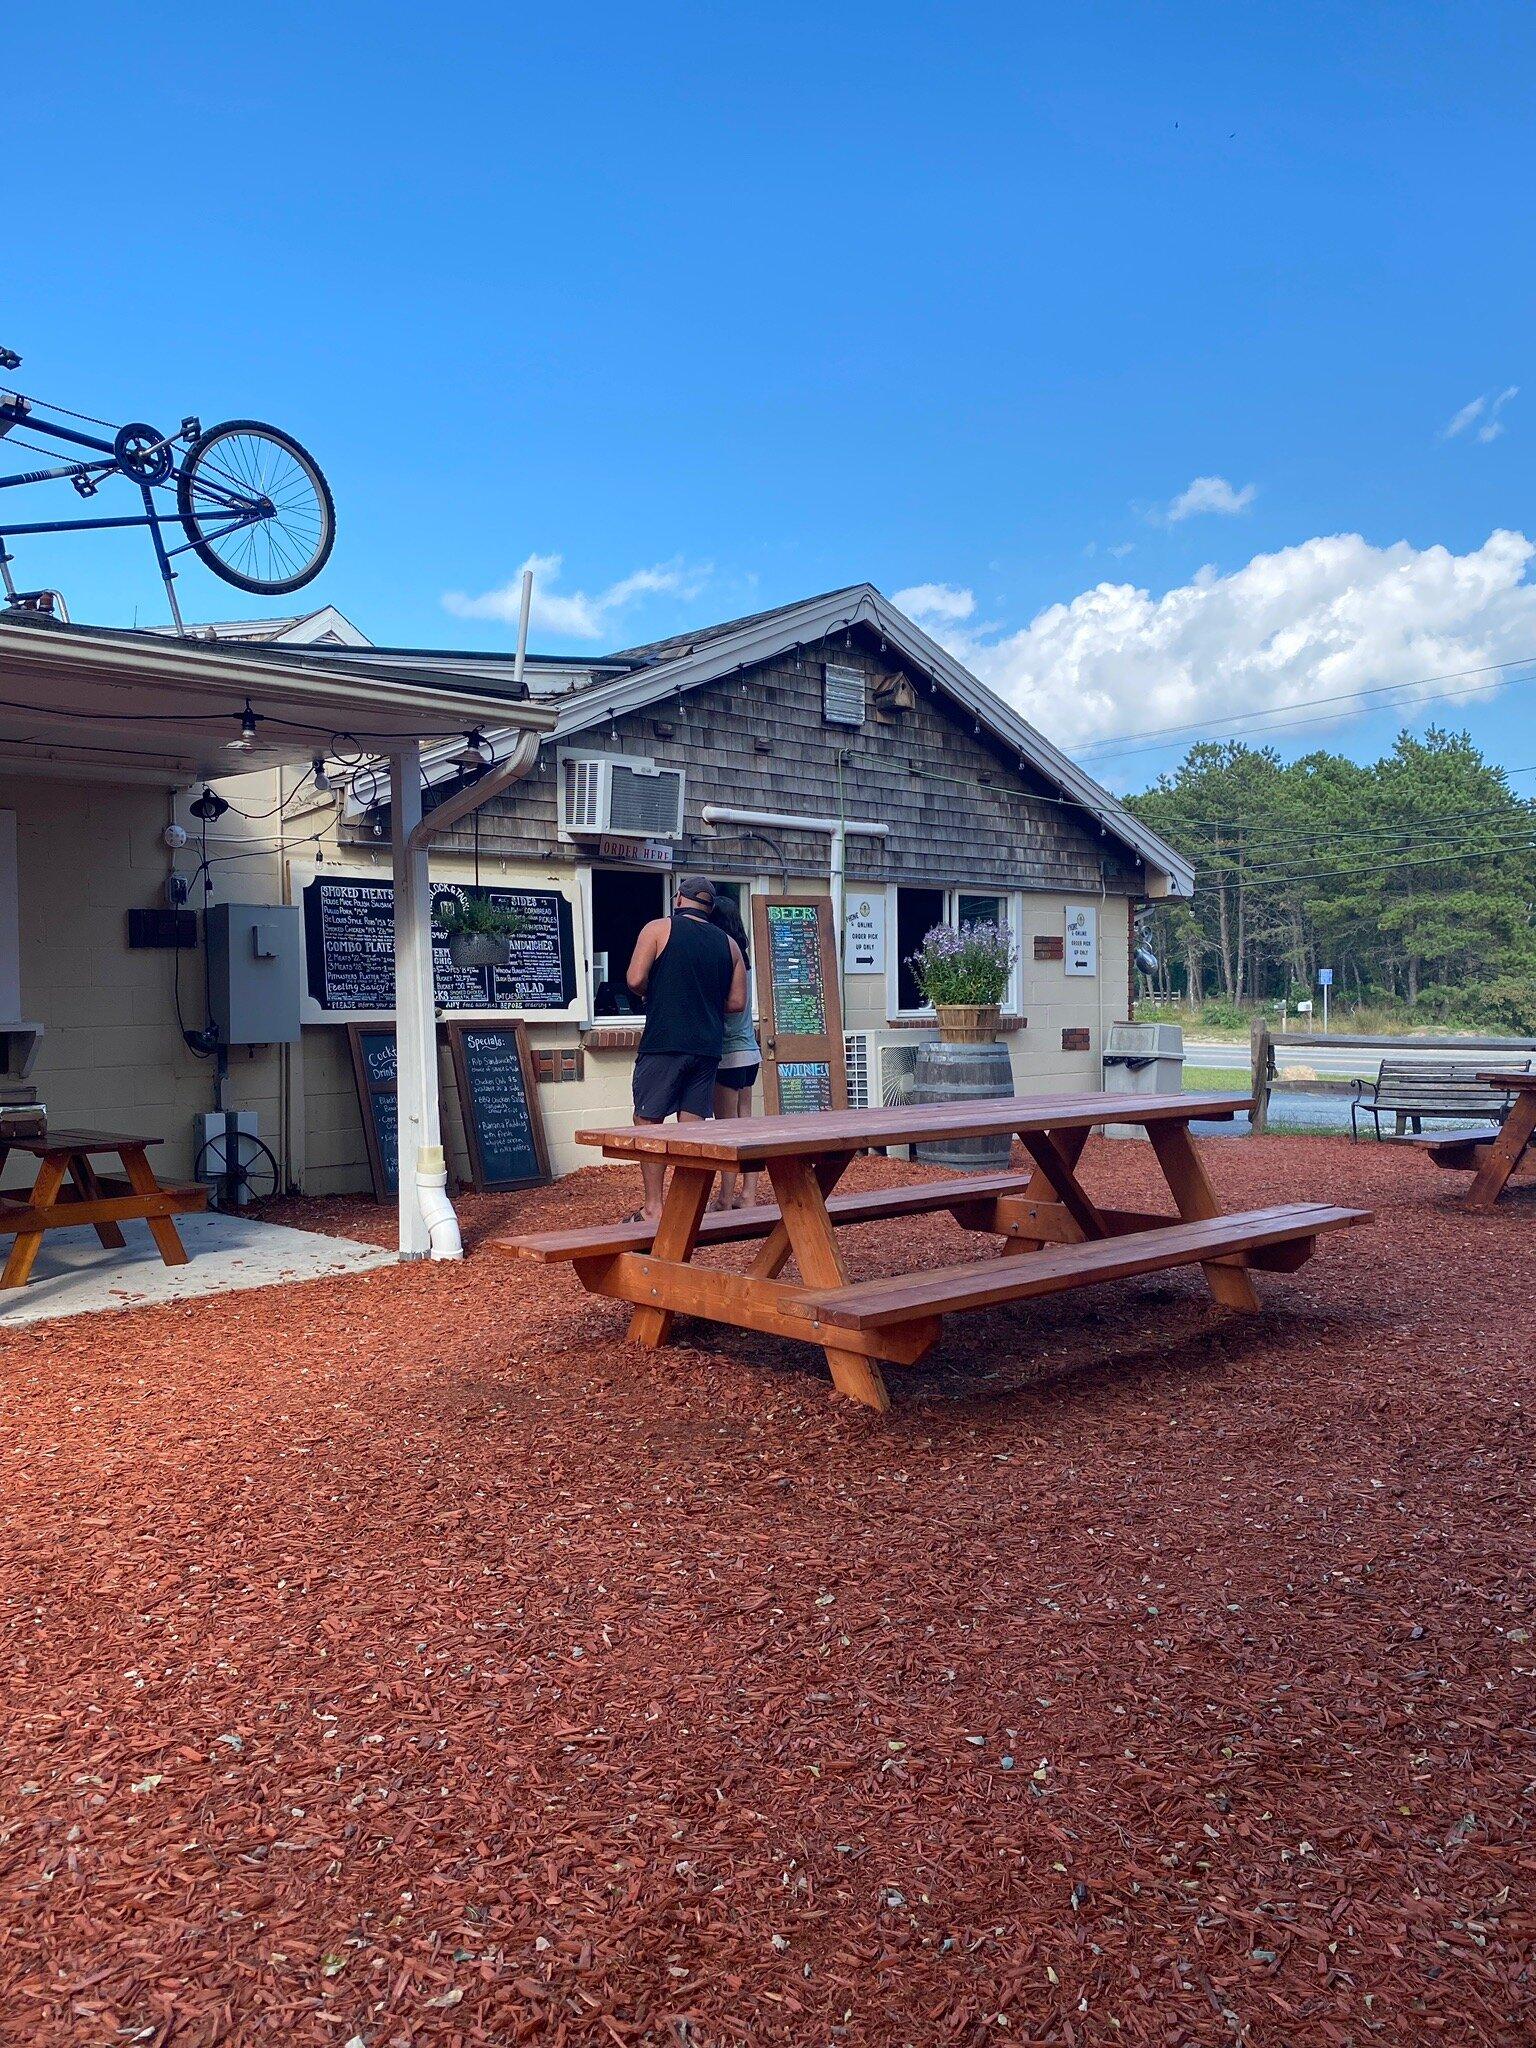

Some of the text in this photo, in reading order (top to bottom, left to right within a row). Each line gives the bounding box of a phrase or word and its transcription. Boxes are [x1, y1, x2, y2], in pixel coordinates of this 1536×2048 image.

[604, 841, 638, 858] ORDER
[322, 888, 394, 899] SMOKED MEATS
[511, 896, 537, 906] SIDES
[768, 907, 814, 920] BEER
[326, 941, 363, 952] COMBO
[509, 940, 554, 951] ANDWICHES
[328, 983, 359, 993] Feeling
[515, 982, 544, 993] SALAD
[331, 1001, 356, 1009] PLEASE
[500, 1002, 523, 1010] BEFORE
[368, 1045, 397, 1067] Cockt
[372, 1066, 397, 1080] Drink
